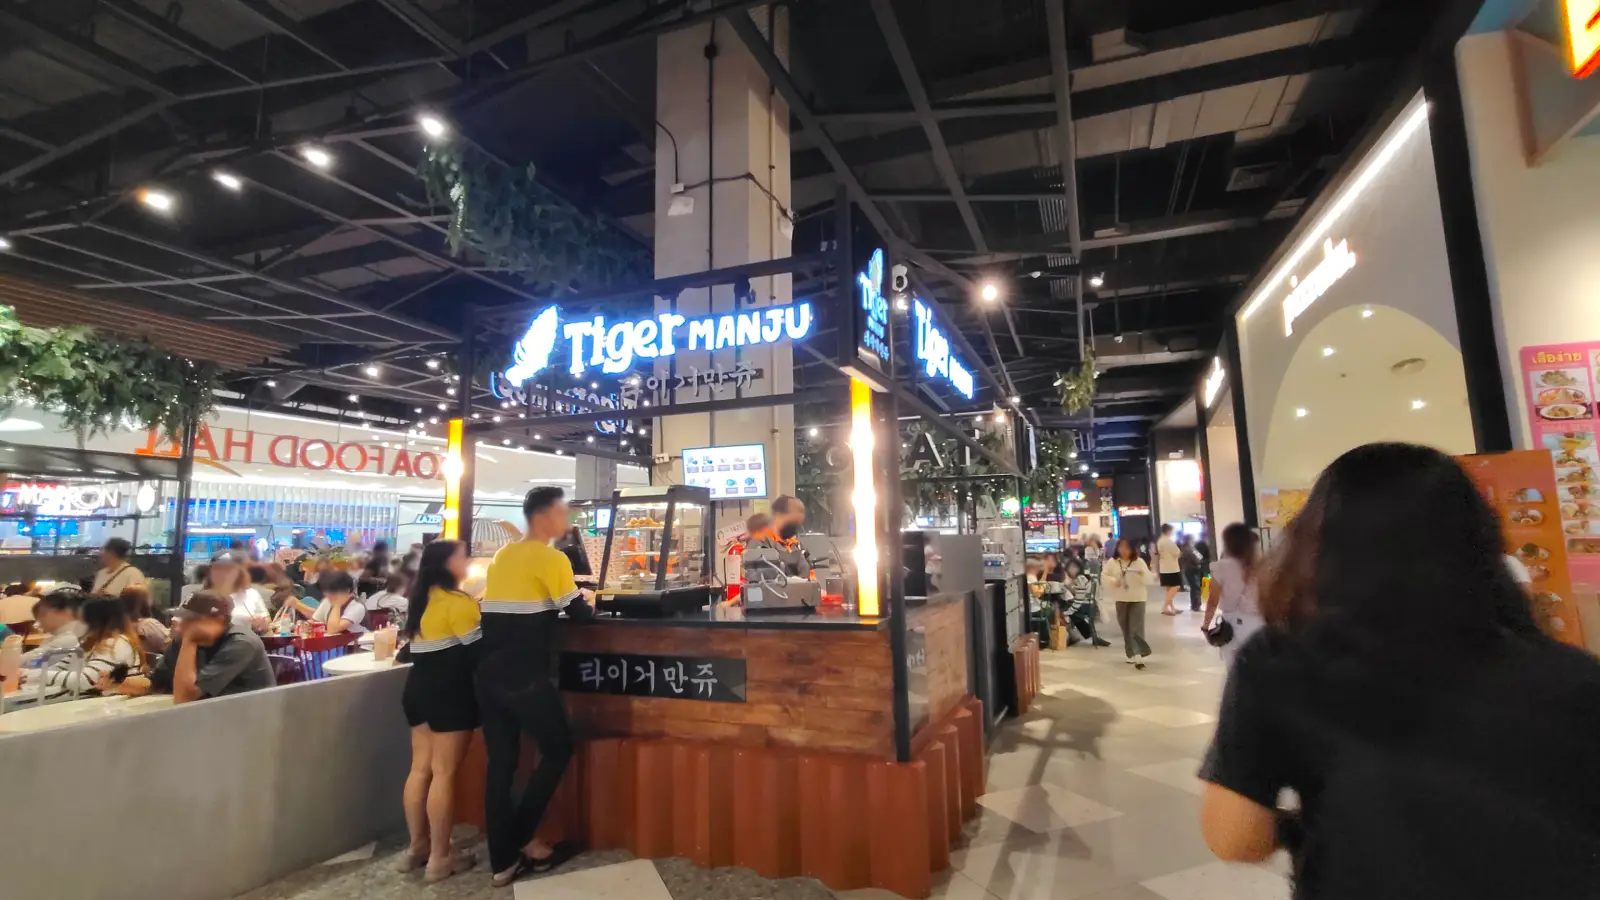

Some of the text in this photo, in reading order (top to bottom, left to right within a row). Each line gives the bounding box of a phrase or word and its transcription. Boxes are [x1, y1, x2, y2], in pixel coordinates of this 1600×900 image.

[563, 313, 685, 374] Tiger
[688, 303, 811, 351] MANJU
[579, 658, 718, 698] 타이거만쥬
